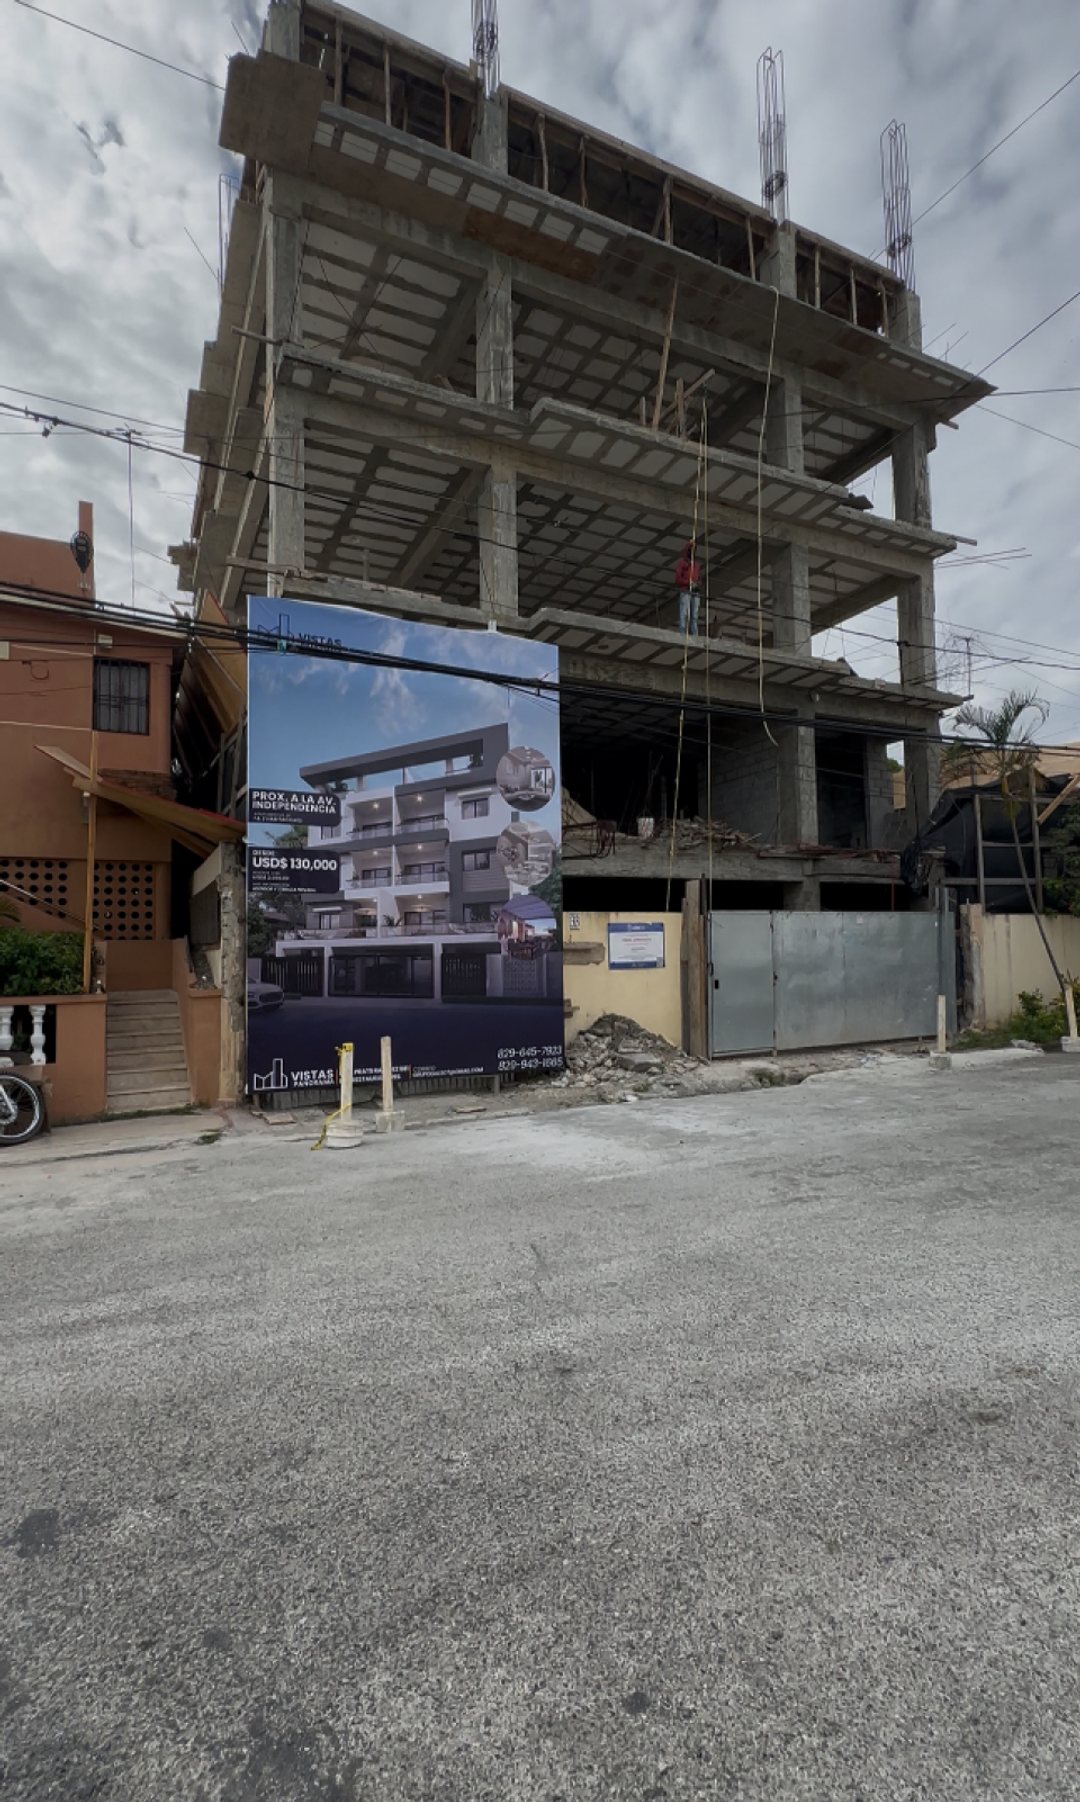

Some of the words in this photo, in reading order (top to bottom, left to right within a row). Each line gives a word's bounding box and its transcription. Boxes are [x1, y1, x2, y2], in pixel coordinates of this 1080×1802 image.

[252, 790, 288, 802] PROX.
[290, 793, 299, 802] A
[302, 794, 315, 804] LA
[317, 795, 337, 806] AV.
[252, 801, 337, 814] INDEPENDENCIA
[252, 856, 289, 869] USD$
[290, 857, 337, 871] 130,000
[290, 1068, 335, 1081] VISTAS
